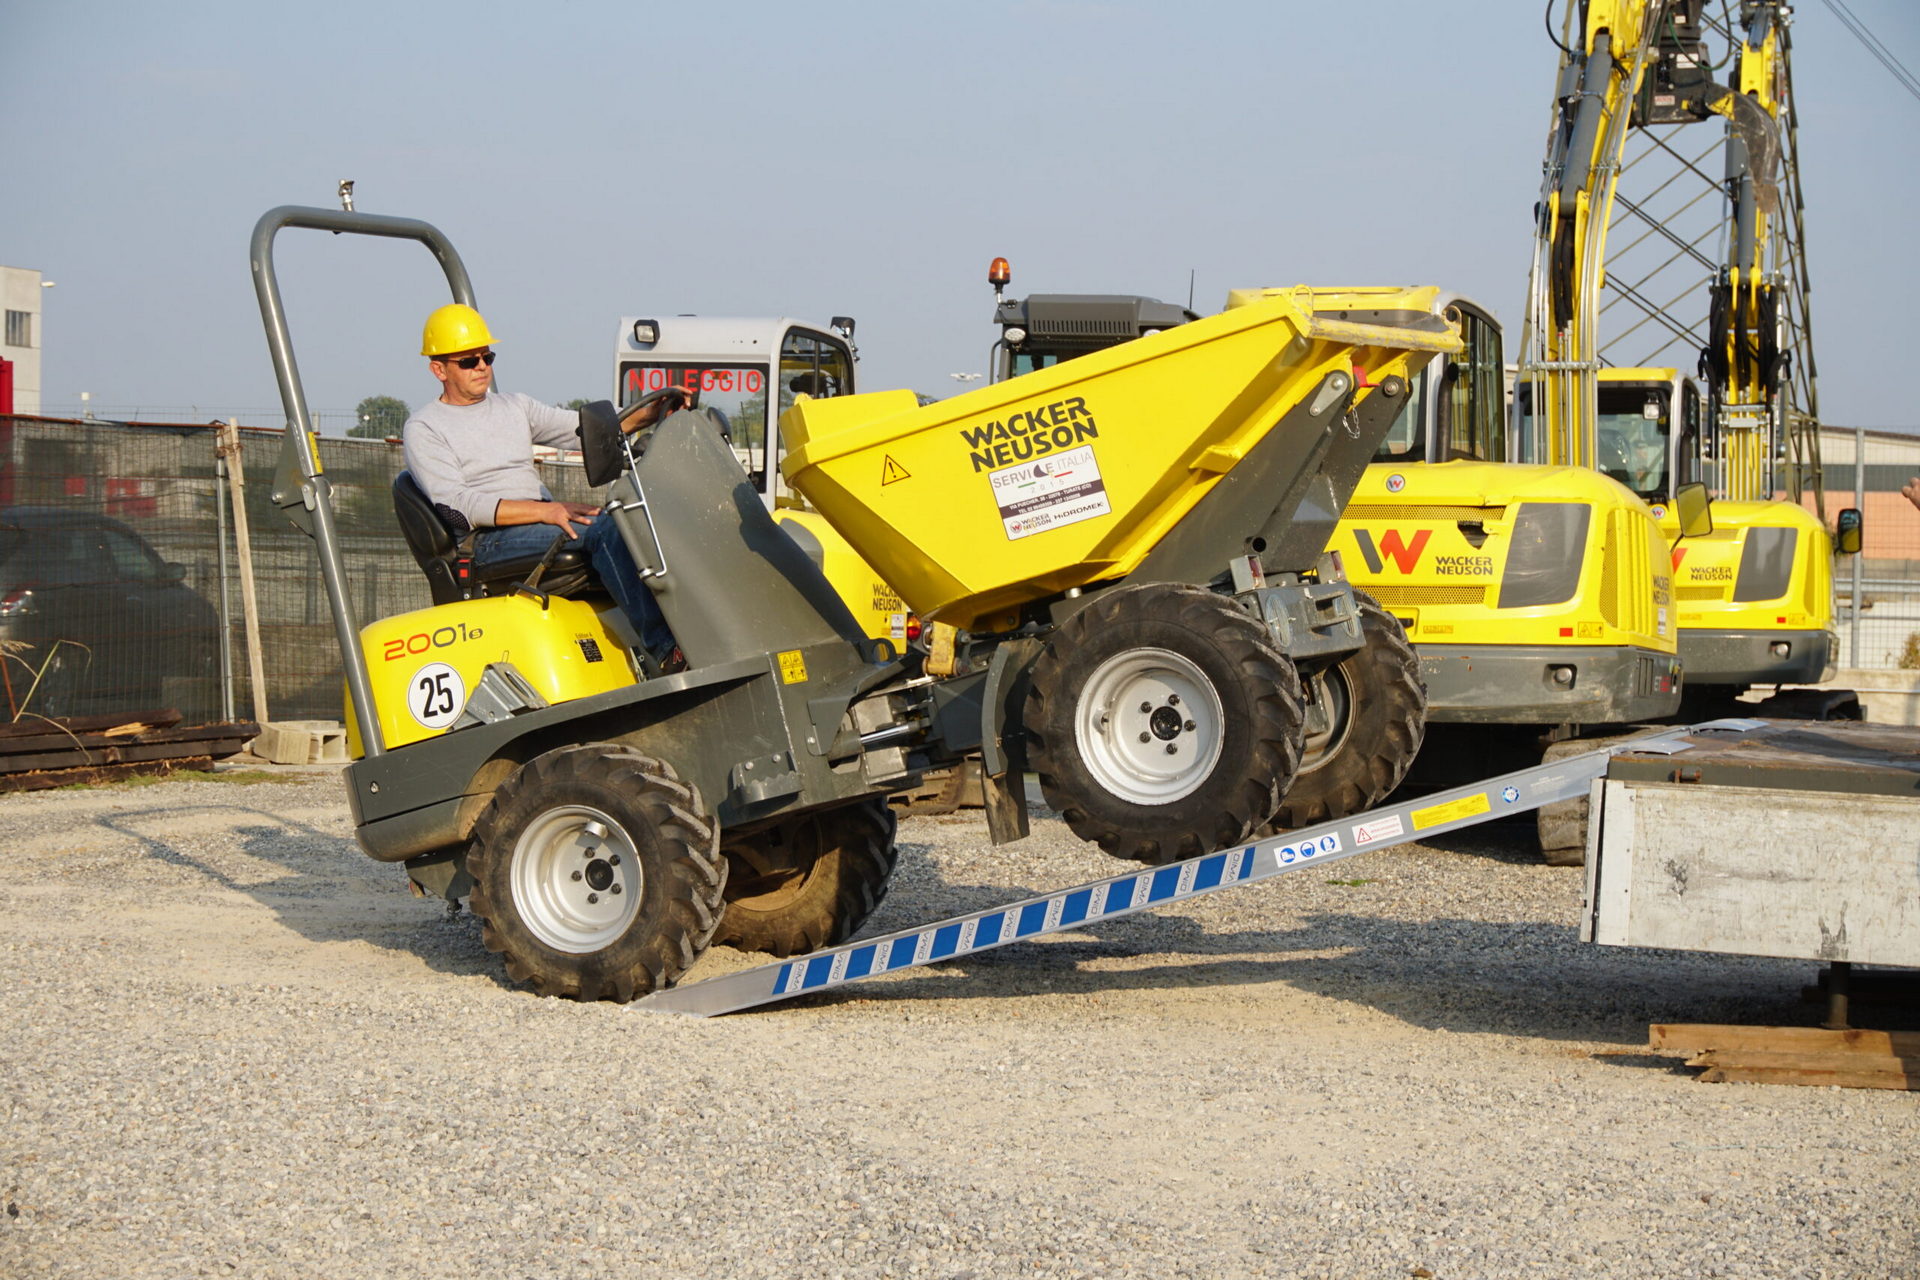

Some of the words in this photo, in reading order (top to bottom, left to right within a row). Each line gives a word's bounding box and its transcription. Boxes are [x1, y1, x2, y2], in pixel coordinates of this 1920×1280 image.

[960, 397, 1092, 449] WACKER
[970, 417, 1099, 473] NEUSON
[1057, 452, 1093, 470] ITALIA
[1021, 513, 1050, 525] WACKER
[1023, 519, 1052, 531] NEUSON
[1435, 556, 1493, 566] WACKER
[1436, 566, 1493, 575] NEUSON
[873, 598, 902, 611] NEUSON
[420, 673, 454, 718] 25
[1003, 909, 1017, 938] DIMA
[918, 931, 930, 960] DIMA
[792, 963, 805, 991] DIMA
[832, 952, 848, 980] DIMA
